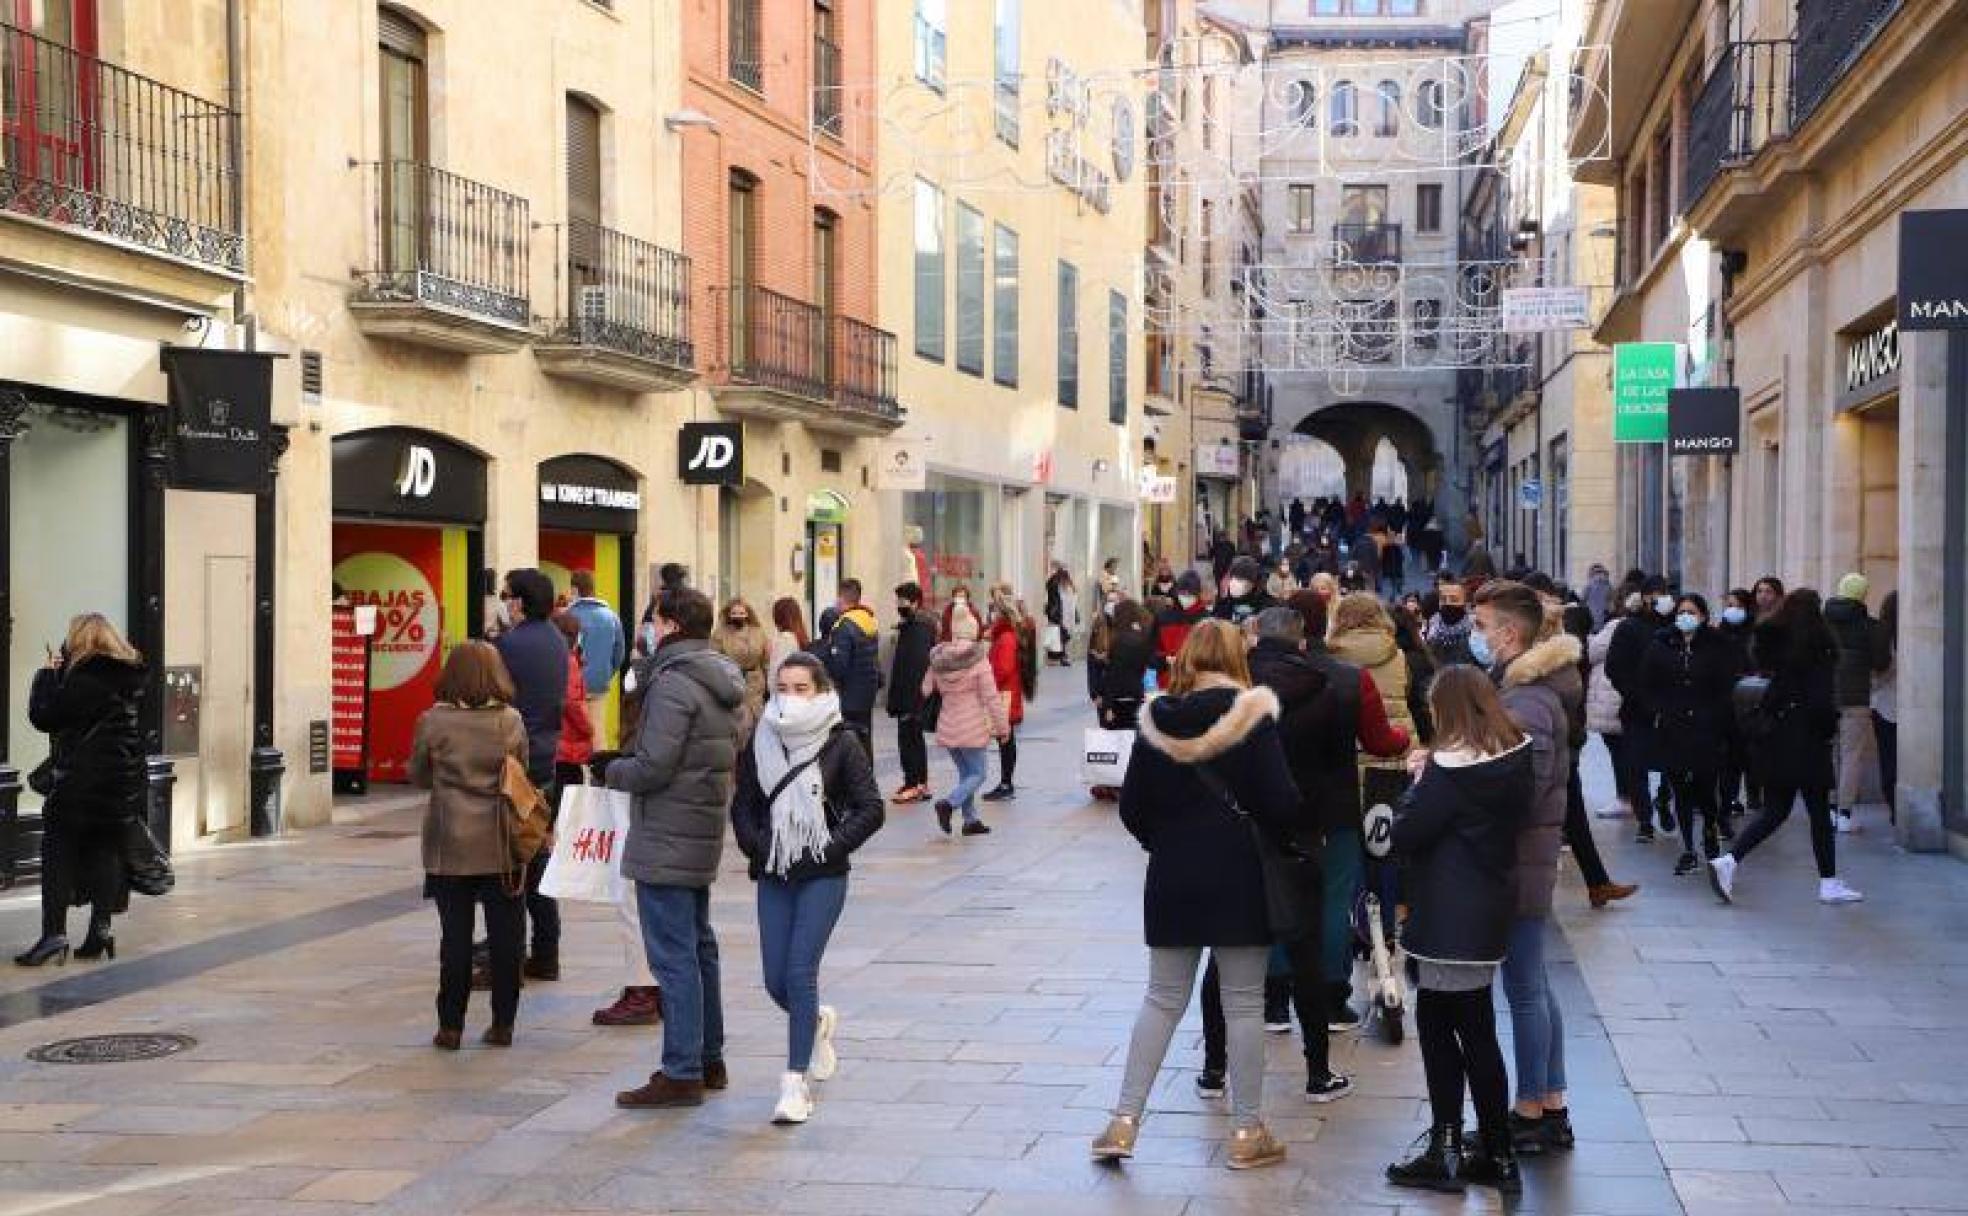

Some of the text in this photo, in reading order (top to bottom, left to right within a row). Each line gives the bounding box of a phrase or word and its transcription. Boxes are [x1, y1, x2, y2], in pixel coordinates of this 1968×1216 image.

[686, 435, 734, 471] JD
[1674, 437, 1733, 449] MANGO
[397, 444, 436, 498] JD
[1368, 816, 1391, 843] JD
